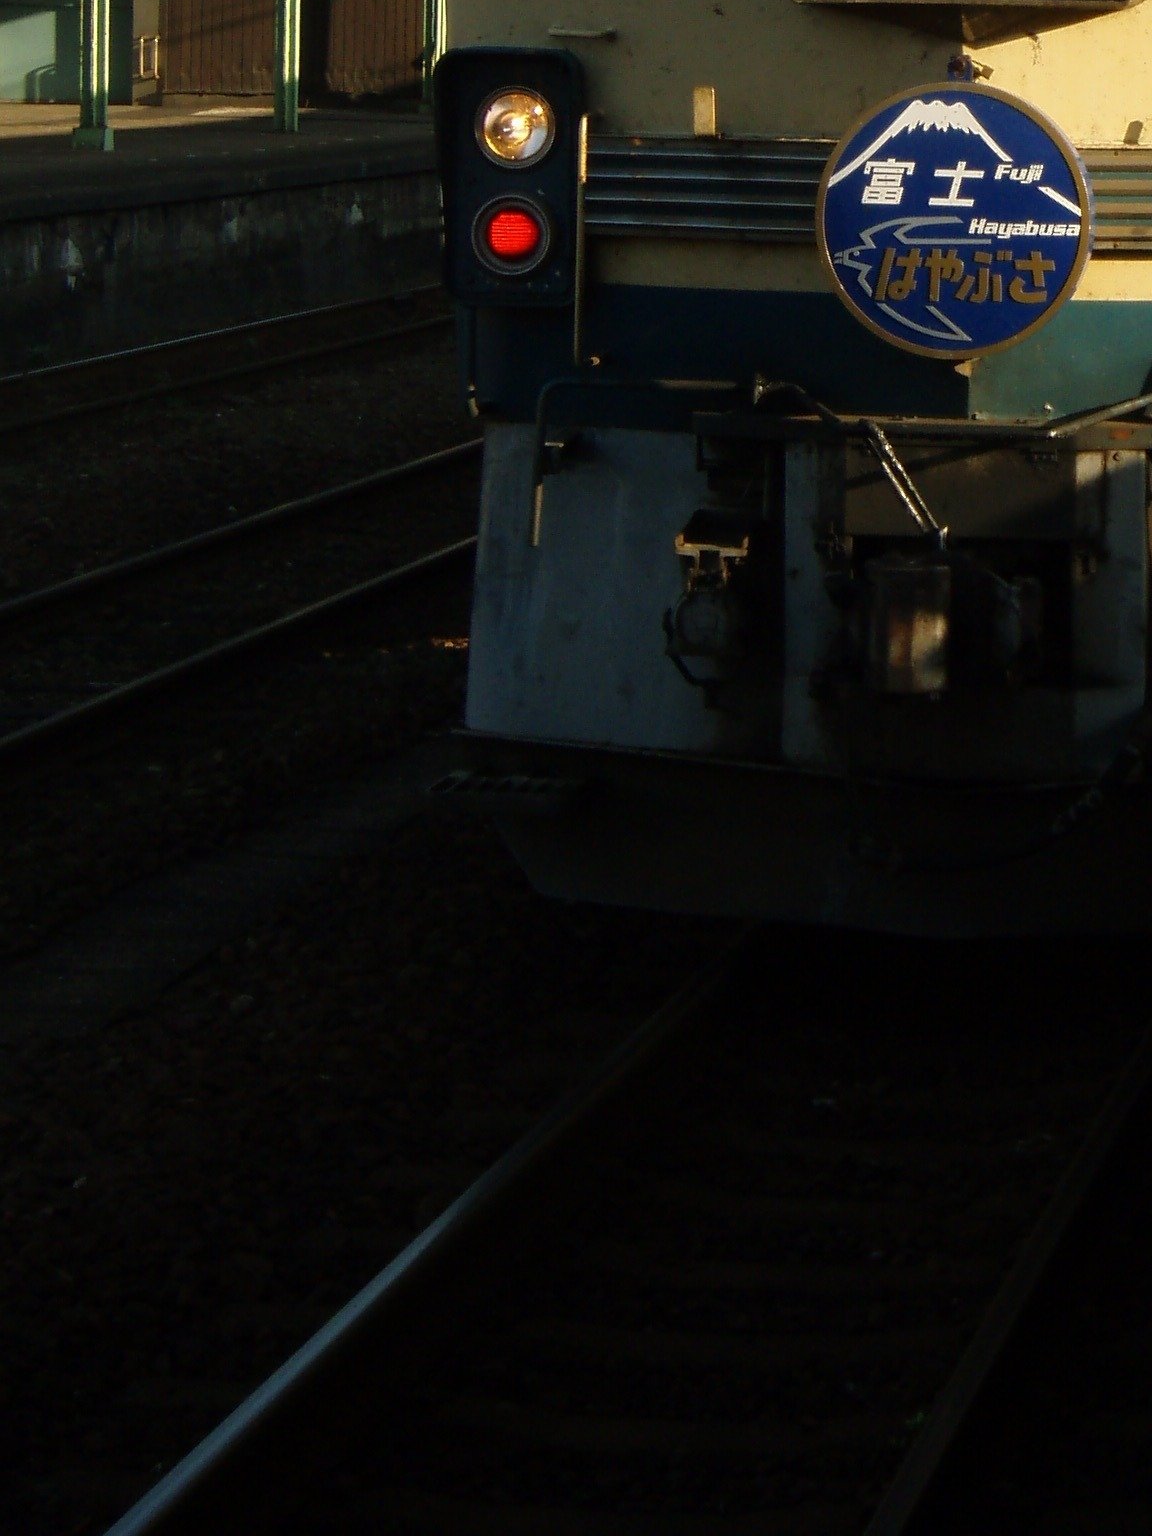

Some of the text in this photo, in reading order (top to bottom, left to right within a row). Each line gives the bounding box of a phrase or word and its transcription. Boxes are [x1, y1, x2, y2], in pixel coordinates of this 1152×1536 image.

[861, 158, 985, 207] 富士
[994, 163, 1044, 184] Fuji
[968, 218, 1082, 240] Hayabusa
[874, 247, 1056, 304] はやぶさ
